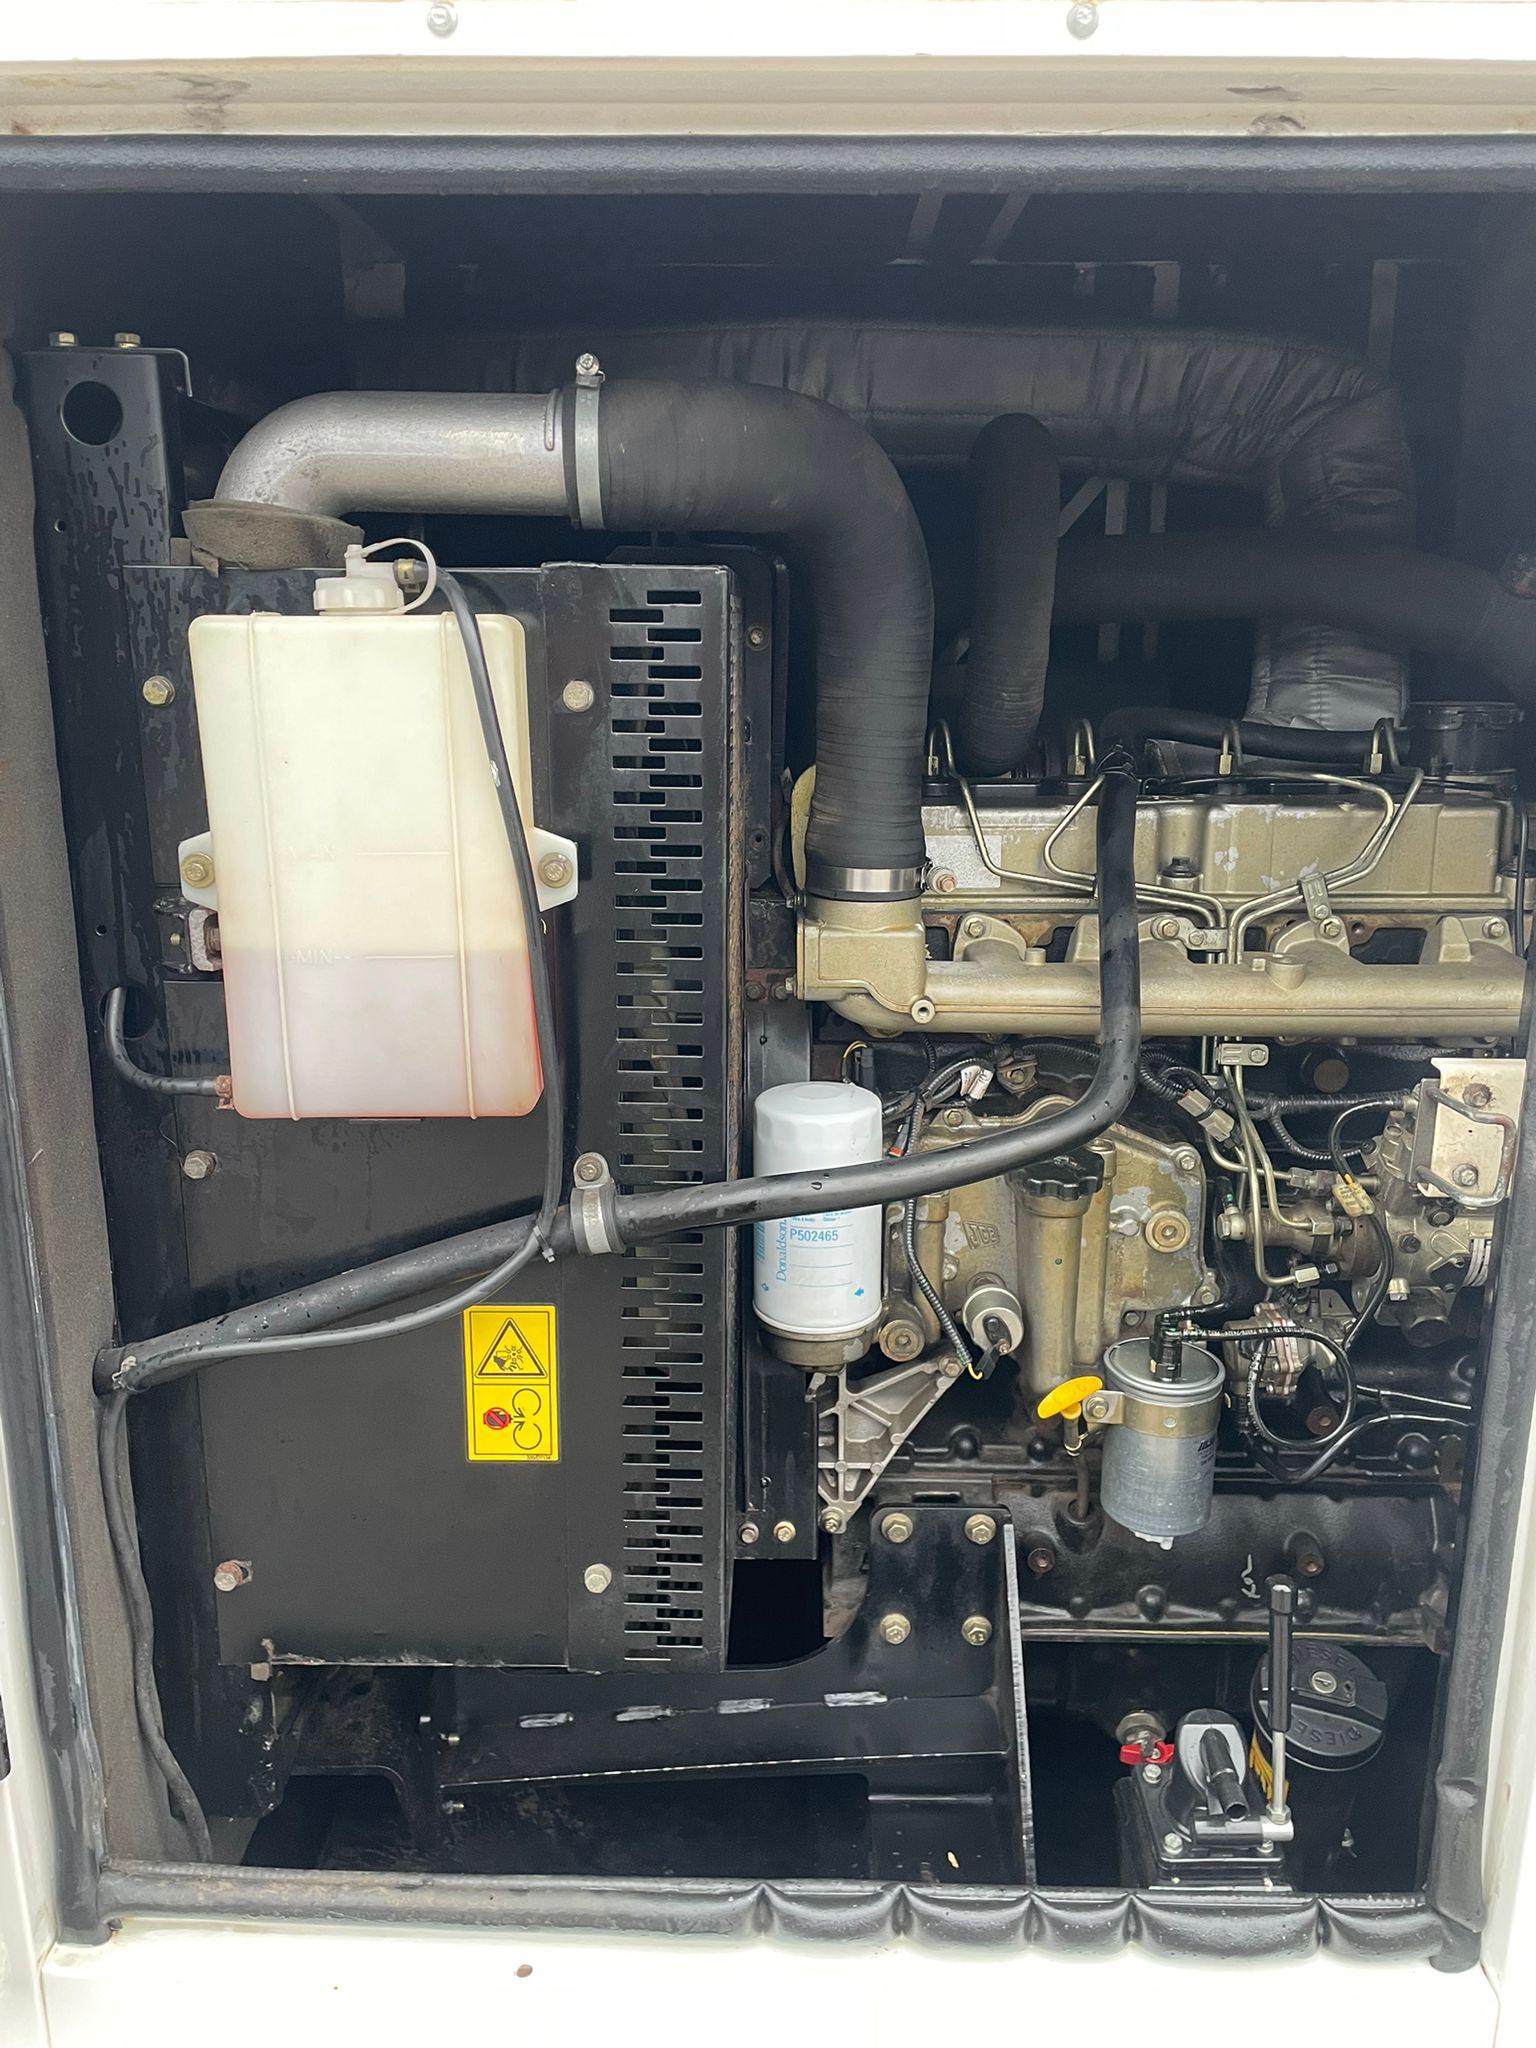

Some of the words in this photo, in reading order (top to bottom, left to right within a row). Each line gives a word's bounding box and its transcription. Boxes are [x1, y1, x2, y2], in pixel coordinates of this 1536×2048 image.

[790, 1228, 839, 1242] P502465
[962, 1221, 1000, 1250] JCB
[1294, 1719, 1362, 1746] DIESE
